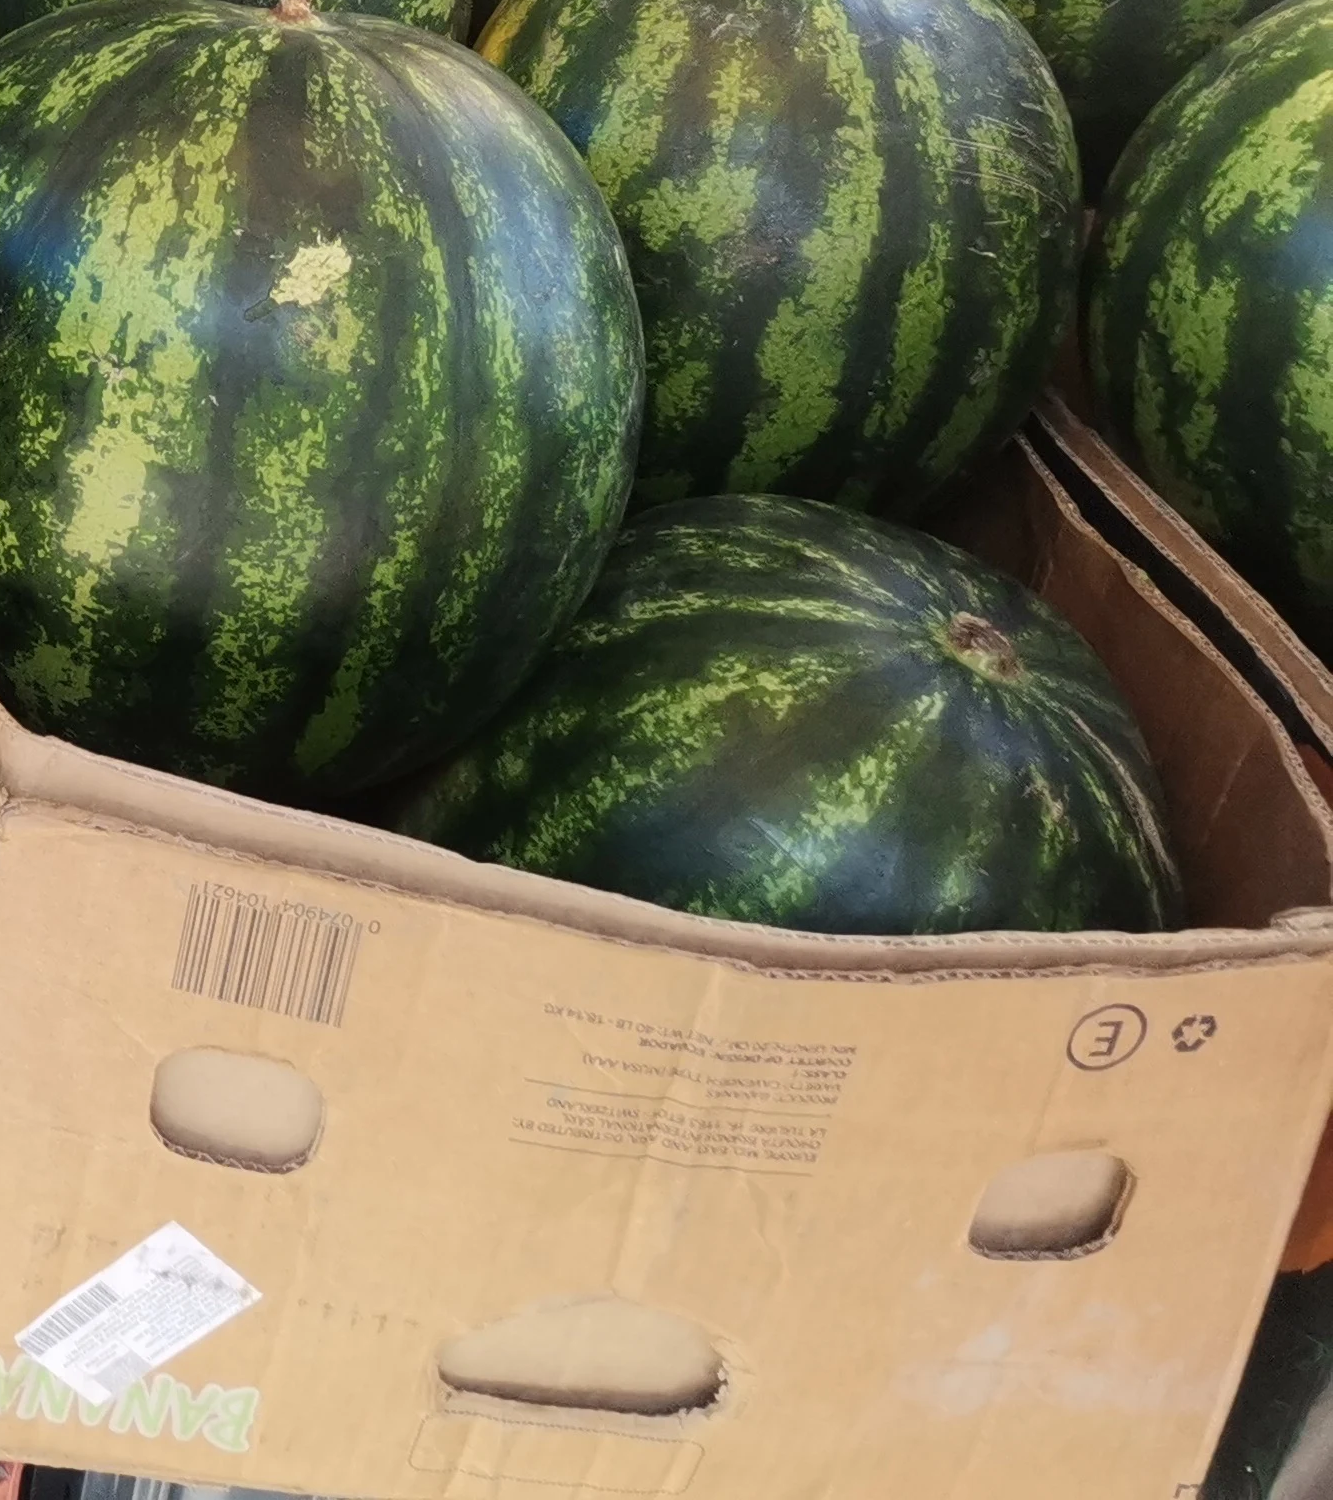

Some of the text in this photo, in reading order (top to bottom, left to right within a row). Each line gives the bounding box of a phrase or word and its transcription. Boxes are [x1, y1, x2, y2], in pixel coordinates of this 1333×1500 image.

[204, 880, 381, 934] 0 074904 104621
[1089, 1018, 1125, 1058] E
